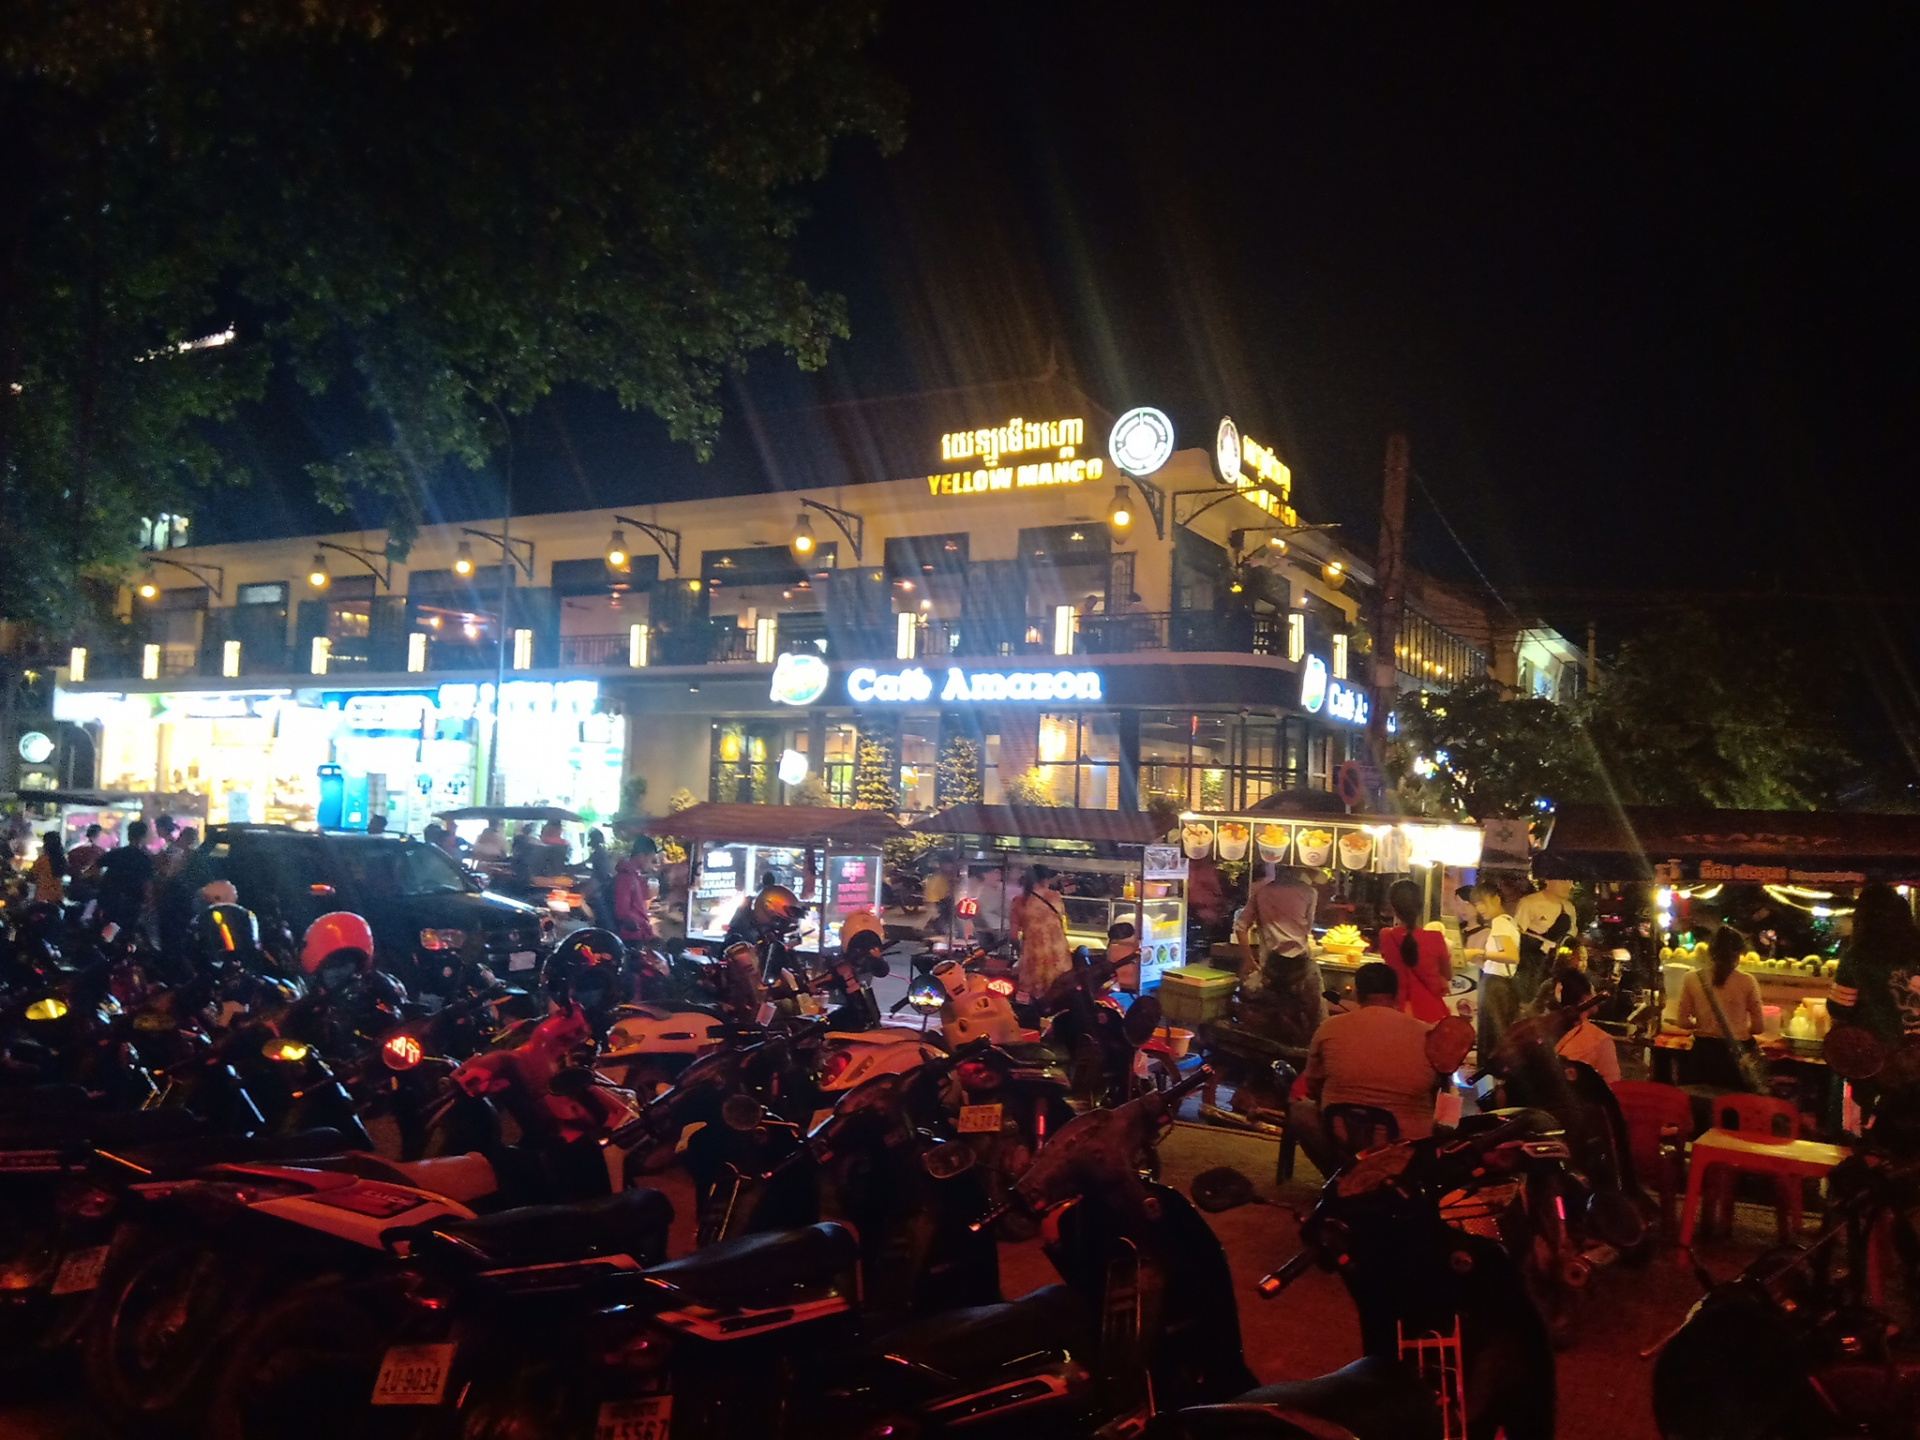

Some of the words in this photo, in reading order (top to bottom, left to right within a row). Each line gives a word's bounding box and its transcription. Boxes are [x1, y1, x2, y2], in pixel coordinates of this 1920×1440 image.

[927, 467, 1013, 497] YELLOW
[1017, 457, 1103, 488] MANGO
[941, 667, 1102, 702] Amazon
